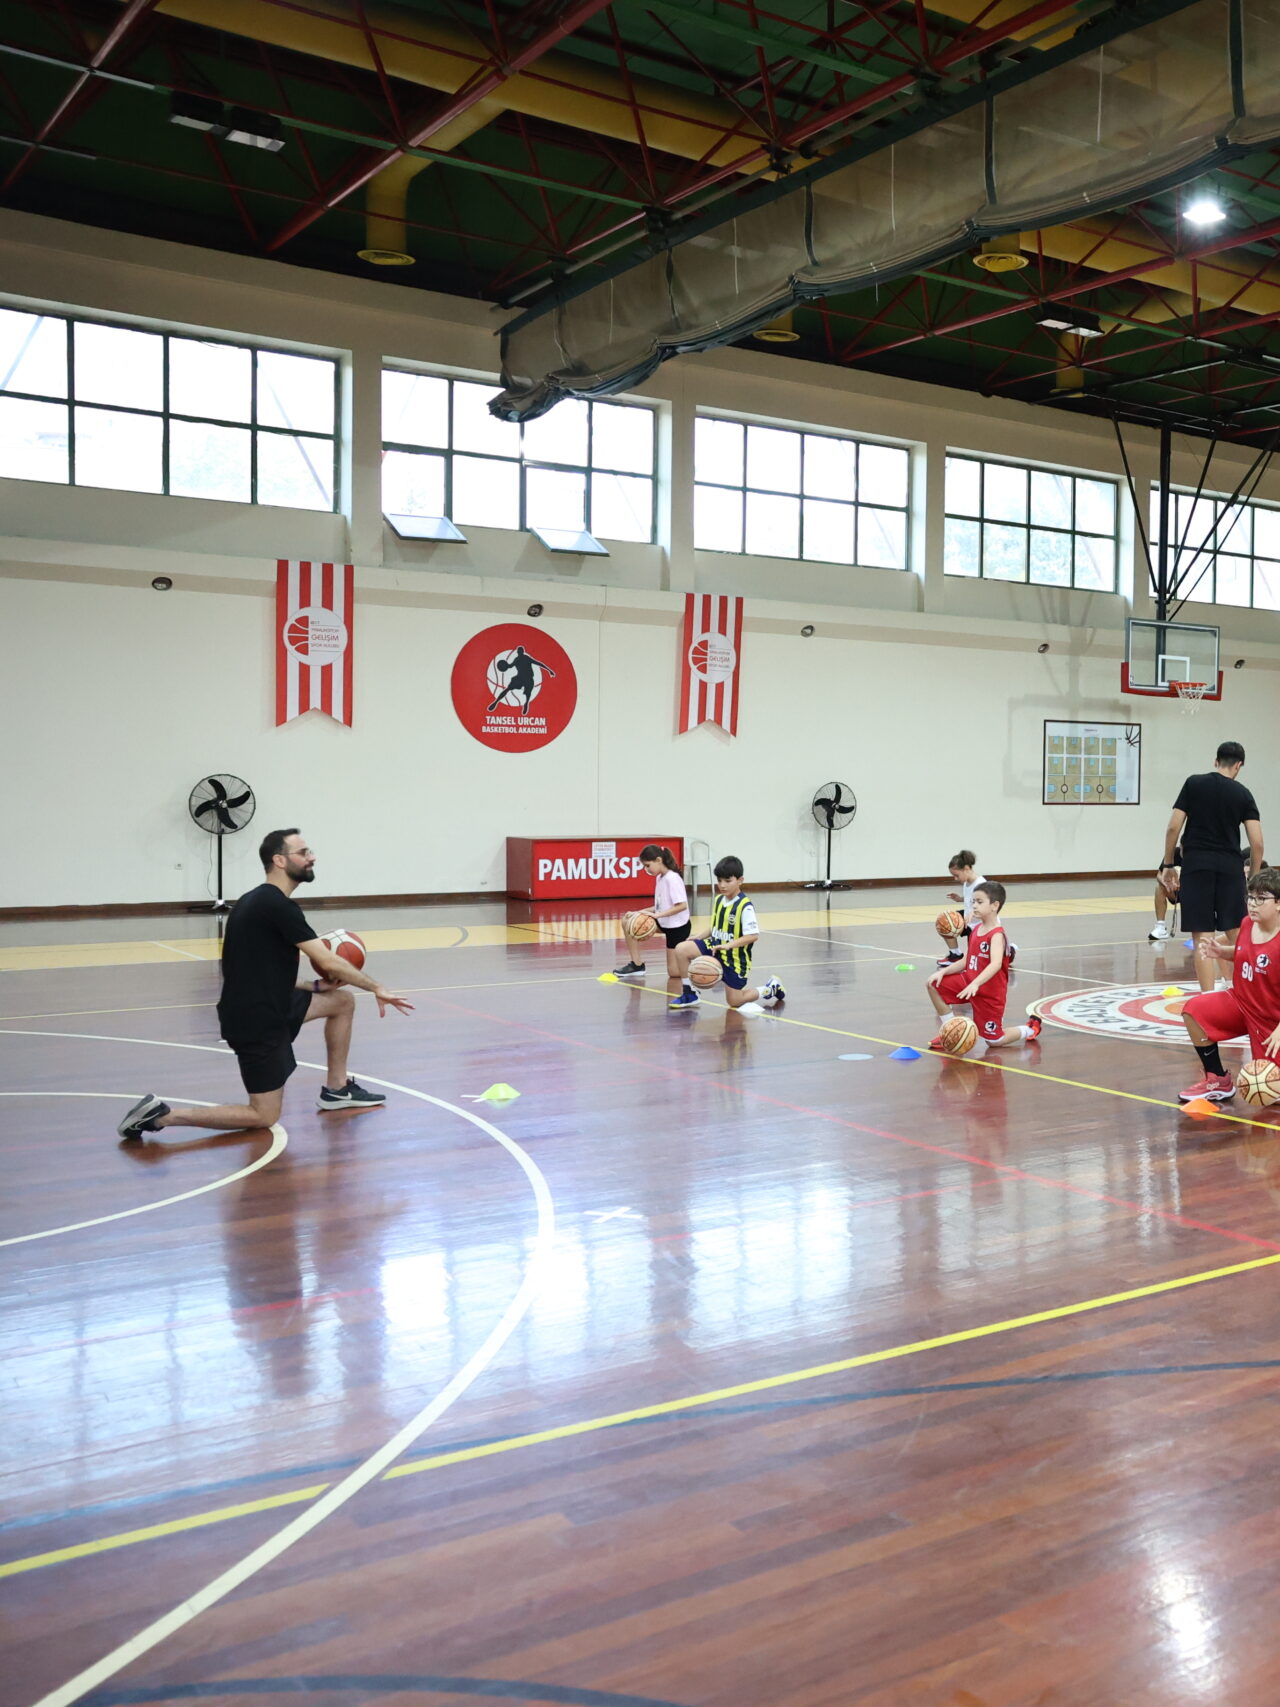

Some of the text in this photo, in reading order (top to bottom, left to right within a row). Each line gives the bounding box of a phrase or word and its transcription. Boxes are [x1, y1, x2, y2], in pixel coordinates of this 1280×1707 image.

[485, 715, 546, 726] TANSEL URCAN
[481, 725, 548, 734] BASKETBOL AKADEMİ
[538, 856, 654, 881] PAMUKSP
[1241, 961, 1253, 982] 90
